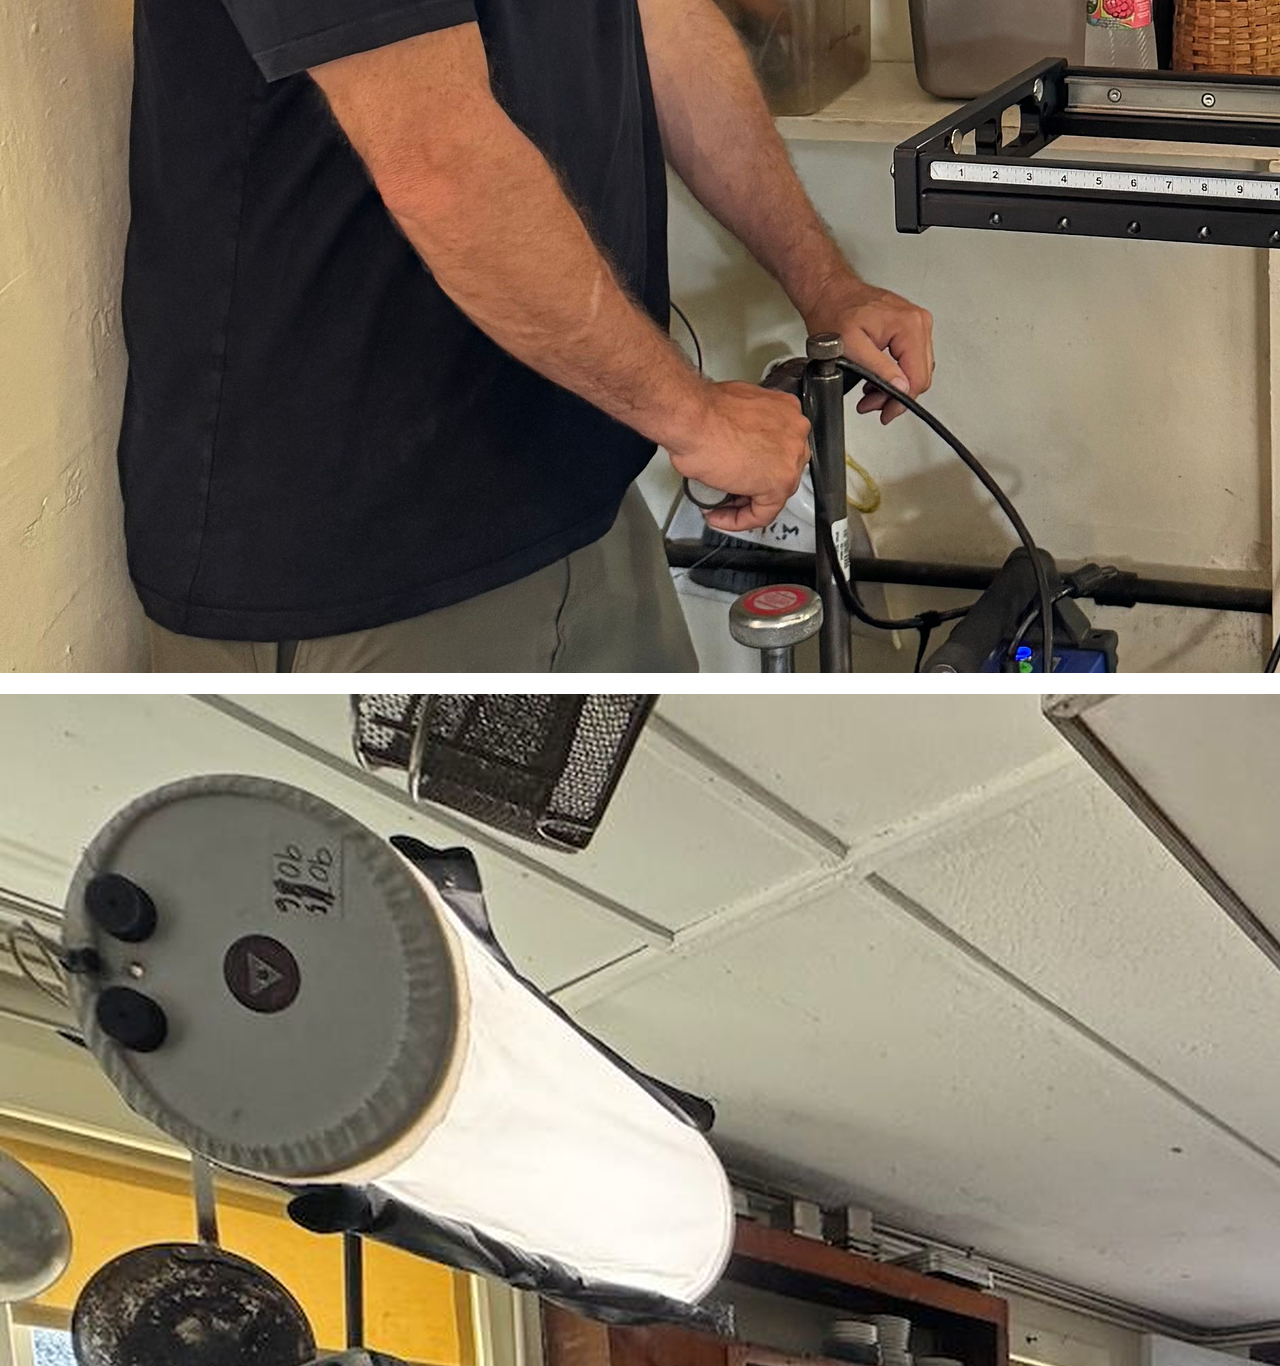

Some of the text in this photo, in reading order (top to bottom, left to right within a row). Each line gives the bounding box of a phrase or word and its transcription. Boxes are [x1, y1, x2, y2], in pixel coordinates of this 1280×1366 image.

[959, 168, 964, 177] 1
[992, 170, 998, 179] 2
[1027, 173, 1033, 181] 3
[1060, 174, 1067, 183] 4
[1096, 176, 1102, 185] 5
[1131, 178, 1137, 187] 6
[1166, 180, 1172, 189] 7
[1201, 183, 1208, 192] 8
[1237, 185, 1243, 194] 9
